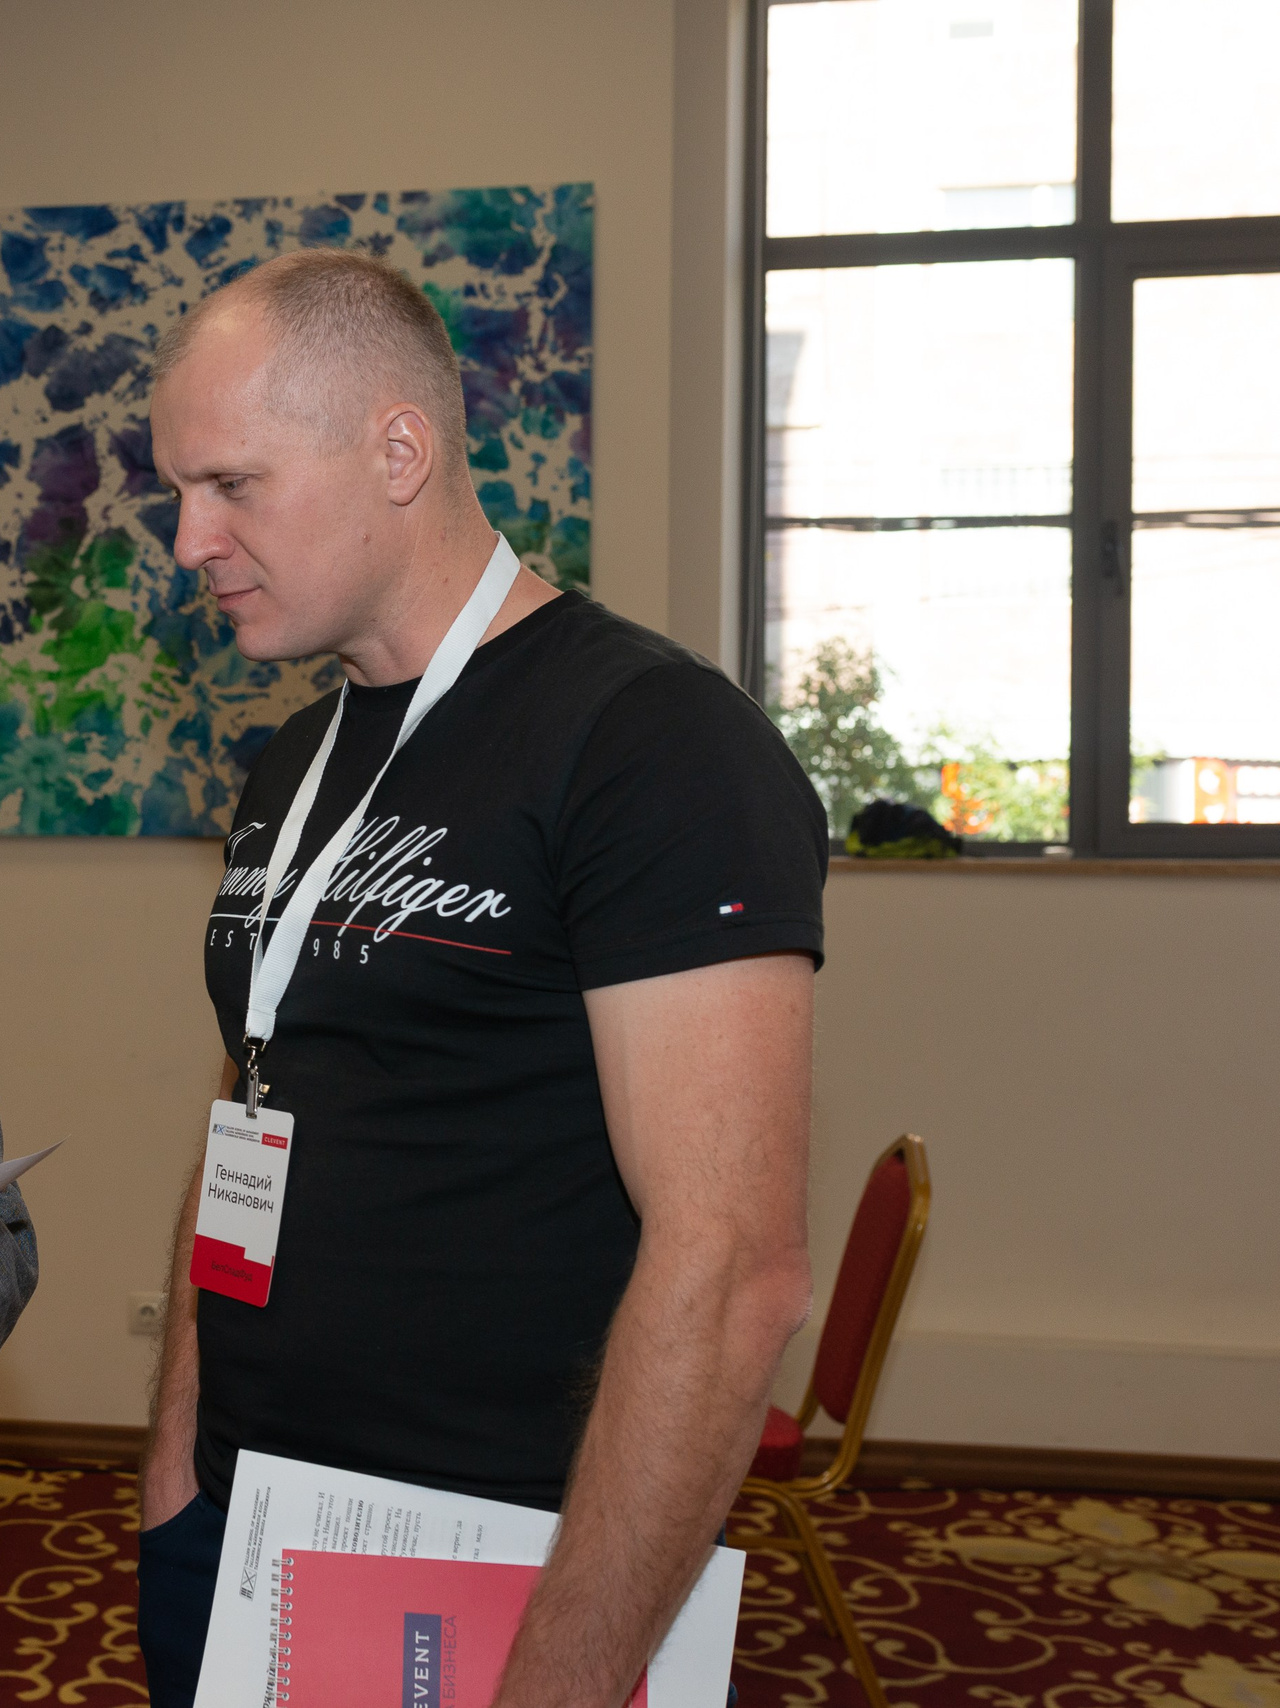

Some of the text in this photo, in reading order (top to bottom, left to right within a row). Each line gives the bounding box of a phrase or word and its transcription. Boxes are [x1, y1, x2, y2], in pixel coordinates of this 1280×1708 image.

[218, 821, 299, 929] Tmmy
[313, 938, 370, 965] 985
[264, 1136, 286, 1146] CLEVENT
[215, 1163, 273, 1192] Геннадий
[207, 1182, 275, 1213] Никанович
[350, 1500, 364, 1554] ководителю
[399, 1510, 412, 1557] уководитель
[442, 1615, 458, 1699] БИЗНЕСА
